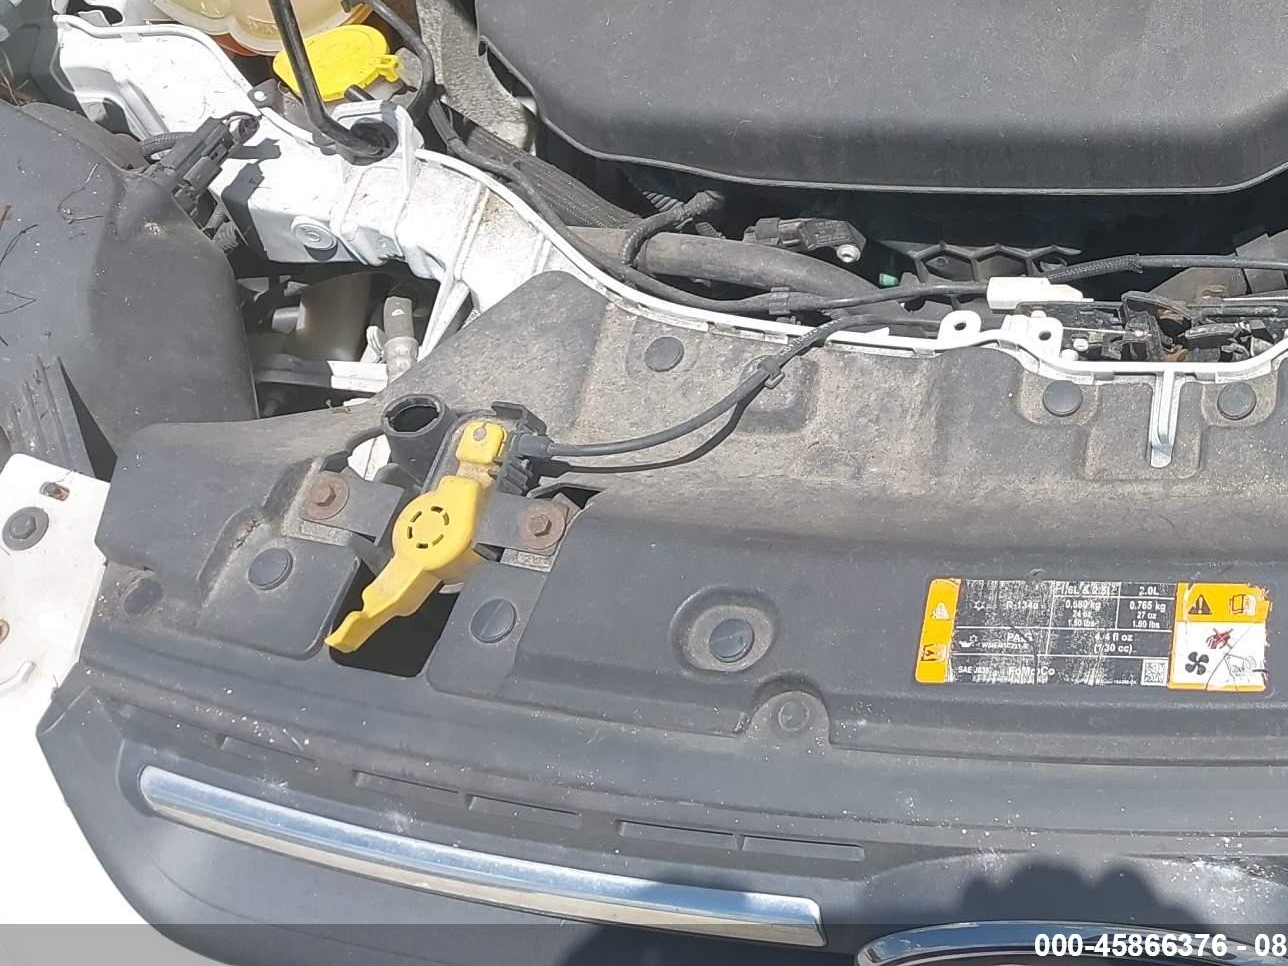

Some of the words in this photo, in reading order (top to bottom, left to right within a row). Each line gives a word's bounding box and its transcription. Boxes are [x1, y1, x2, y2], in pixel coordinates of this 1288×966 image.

[1139, 586, 1159, 596] 2.0L
[1090, 600, 1101, 611] kg
[1129, 601, 1152, 610] 0.765
[1155, 601, 1166, 613] kg
[1072, 610, 1081, 618] 24
[1149, 620, 1160, 628] lbs
[1113, 632, 1119, 641] fl
[1121, 634, 1133, 642] oz
[1118, 645, 1133, 654] cc)
[1008, 666, 1055, 677] FoMoCo
